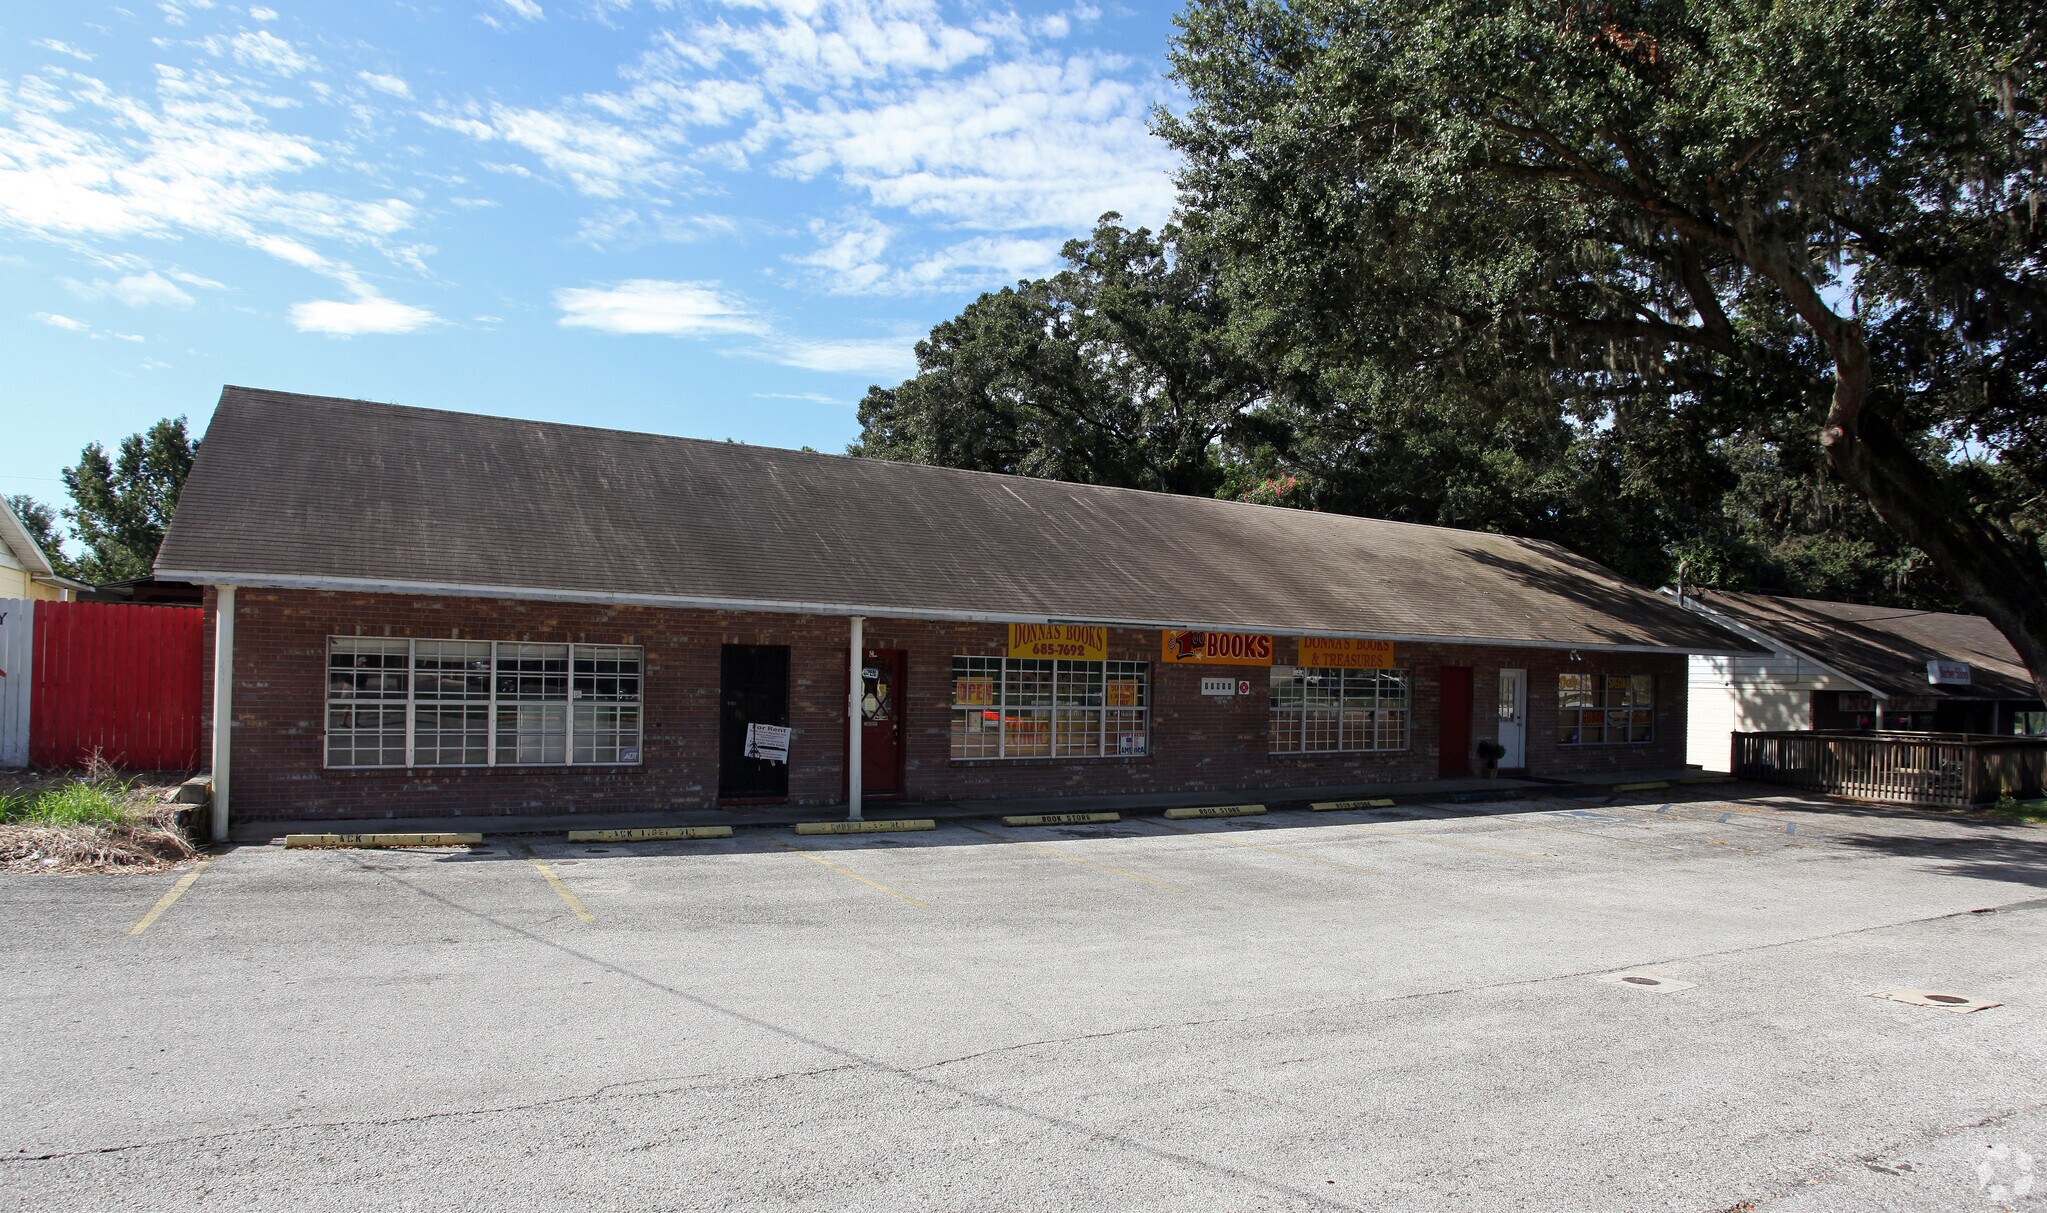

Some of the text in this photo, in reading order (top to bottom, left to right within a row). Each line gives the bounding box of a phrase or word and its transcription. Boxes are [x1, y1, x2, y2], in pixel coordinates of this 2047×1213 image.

[1066, 625, 1103, 652] BOOKS
[1356, 639, 1390, 652] BOOKS
[1033, 643, 1085, 656] 685-7692
[1206, 633, 1270, 660] BOOKS
[1312, 653, 1383, 667] & TREASURES
[1955, 666, 1969, 683] Shop
[957, 683, 993, 701] OPEN
[623, 752, 638, 760] ADT
[1066, 813, 1091, 822] STORE
